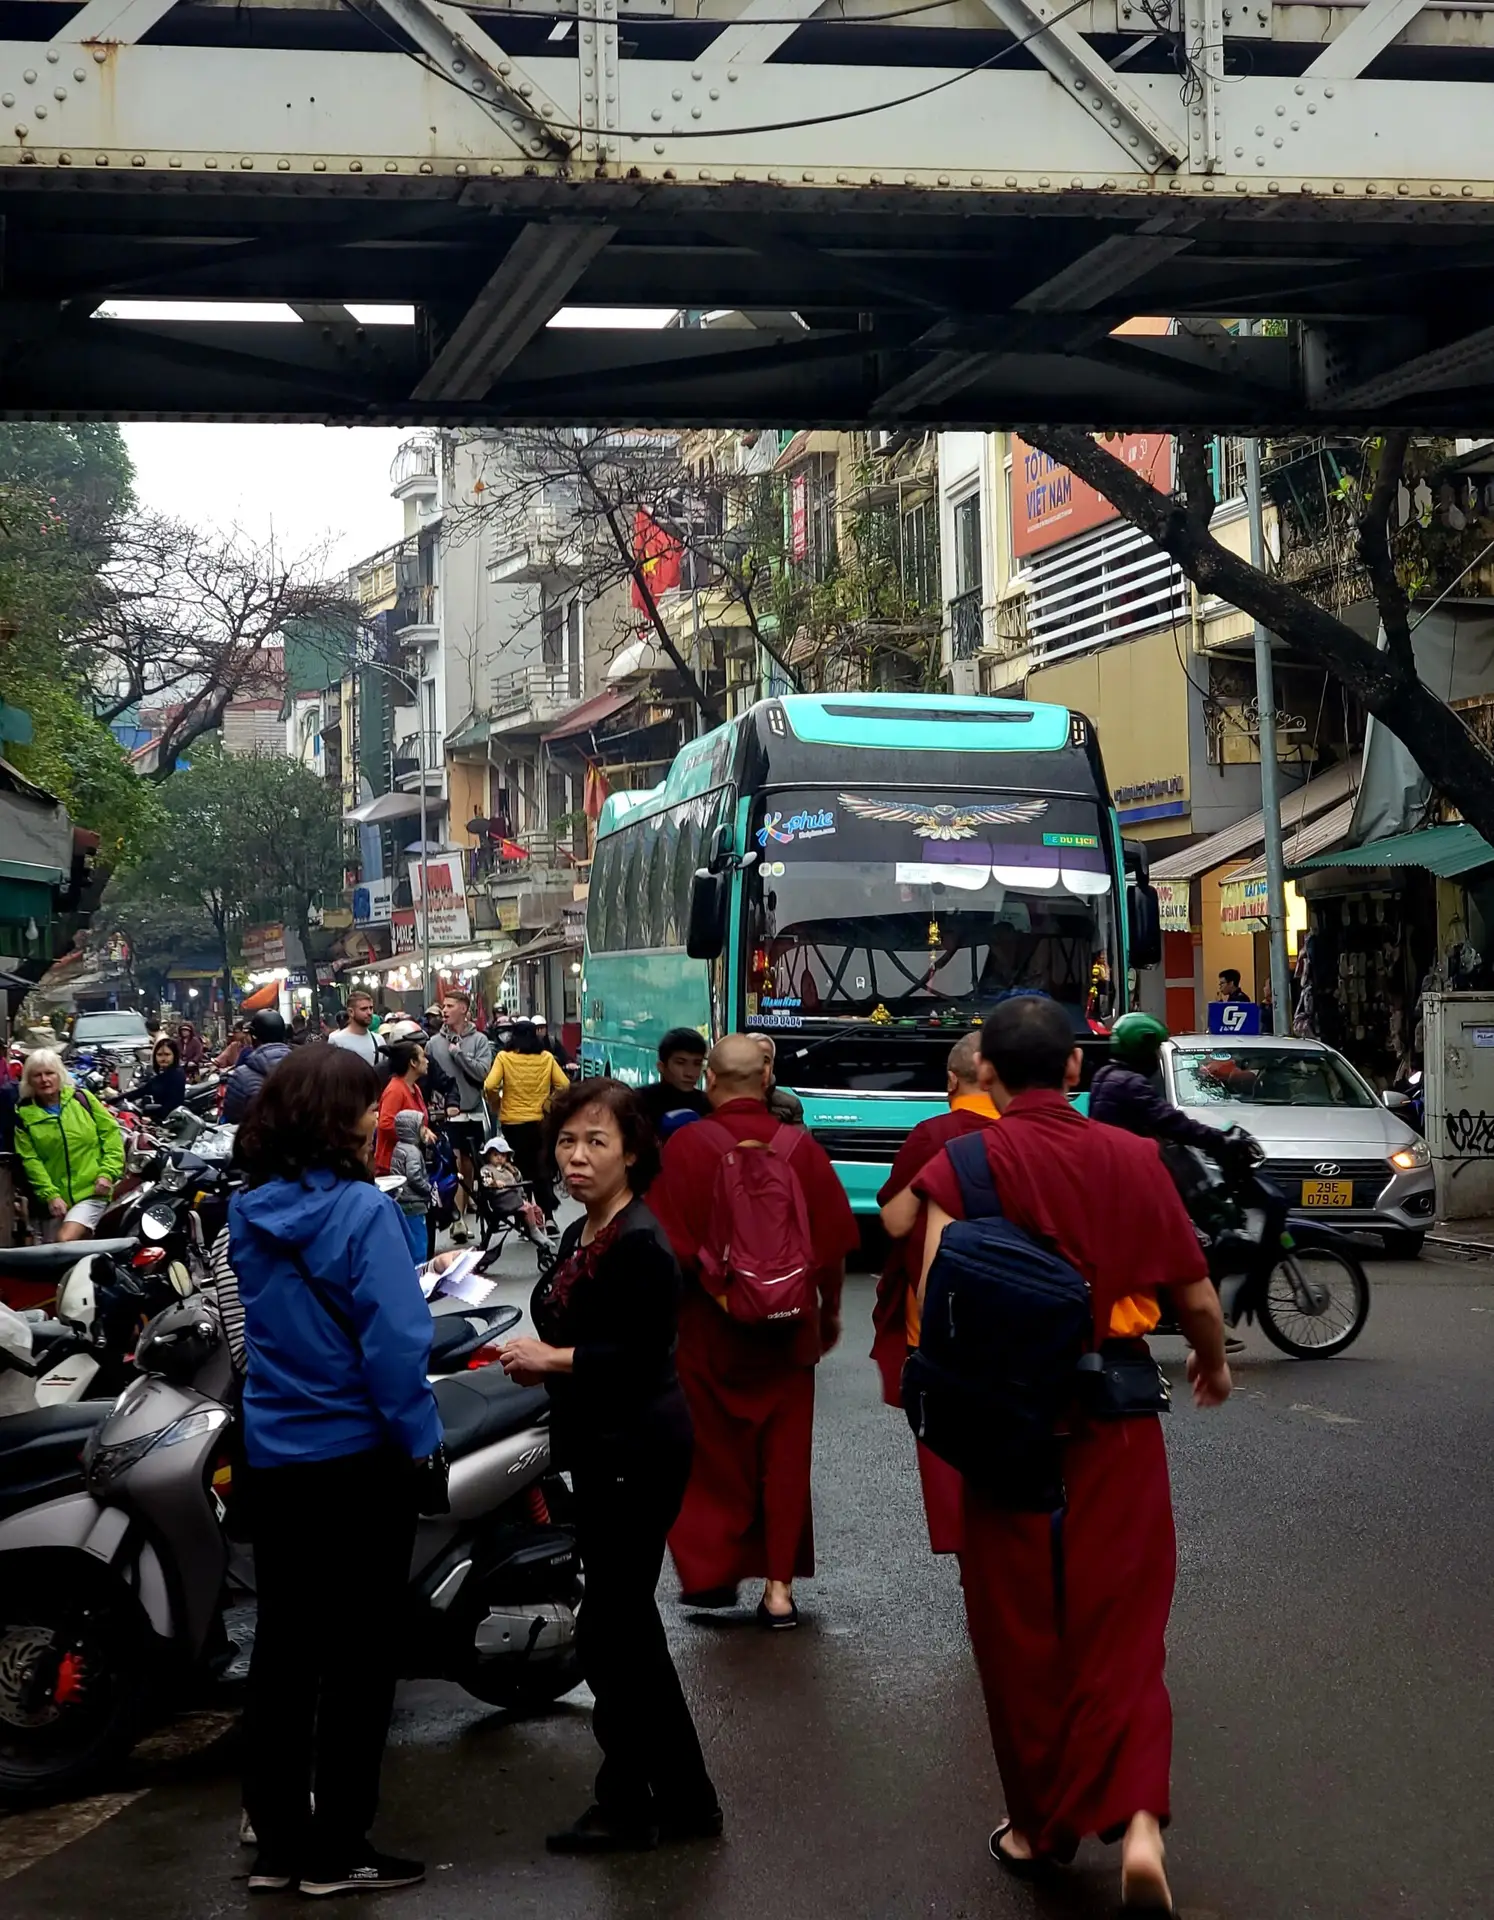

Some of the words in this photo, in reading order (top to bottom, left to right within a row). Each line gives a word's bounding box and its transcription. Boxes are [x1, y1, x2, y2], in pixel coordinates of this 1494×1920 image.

[1049, 471, 1072, 511] NAM
[1060, 836, 1073, 844] DU
[1222, 1005, 1247, 1032] G7
[1316, 1182, 1339, 1193] 29E
[1307, 1194, 1348, 1205] 079.47
[767, 1310, 792, 1319] adidas
